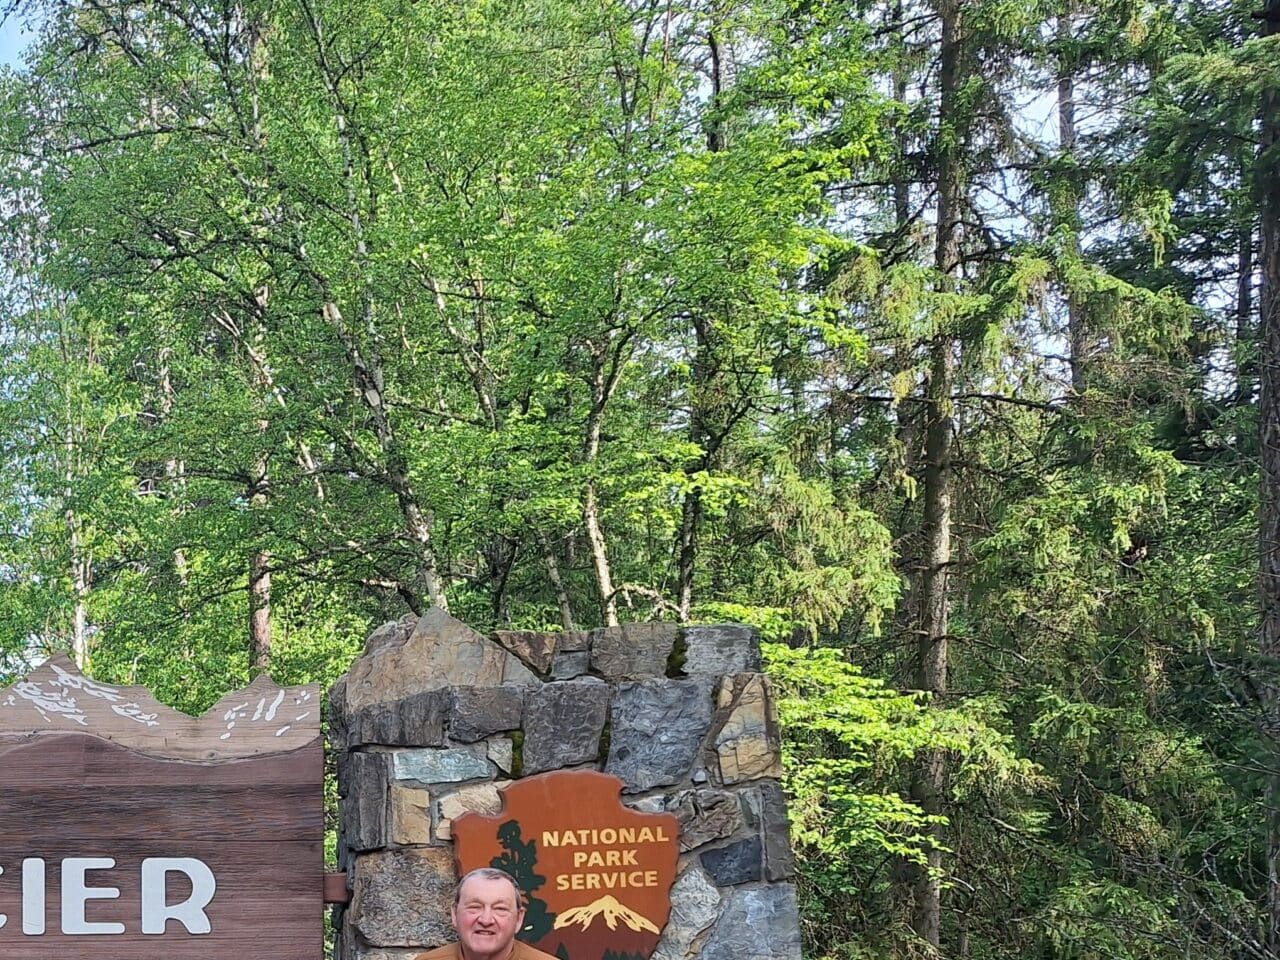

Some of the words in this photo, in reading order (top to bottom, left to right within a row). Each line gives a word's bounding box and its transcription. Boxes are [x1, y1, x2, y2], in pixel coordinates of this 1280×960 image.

[542, 826, 669, 847] NATIONAL
[573, 849, 639, 868] PARK
[556, 870, 658, 891] SERVICE
